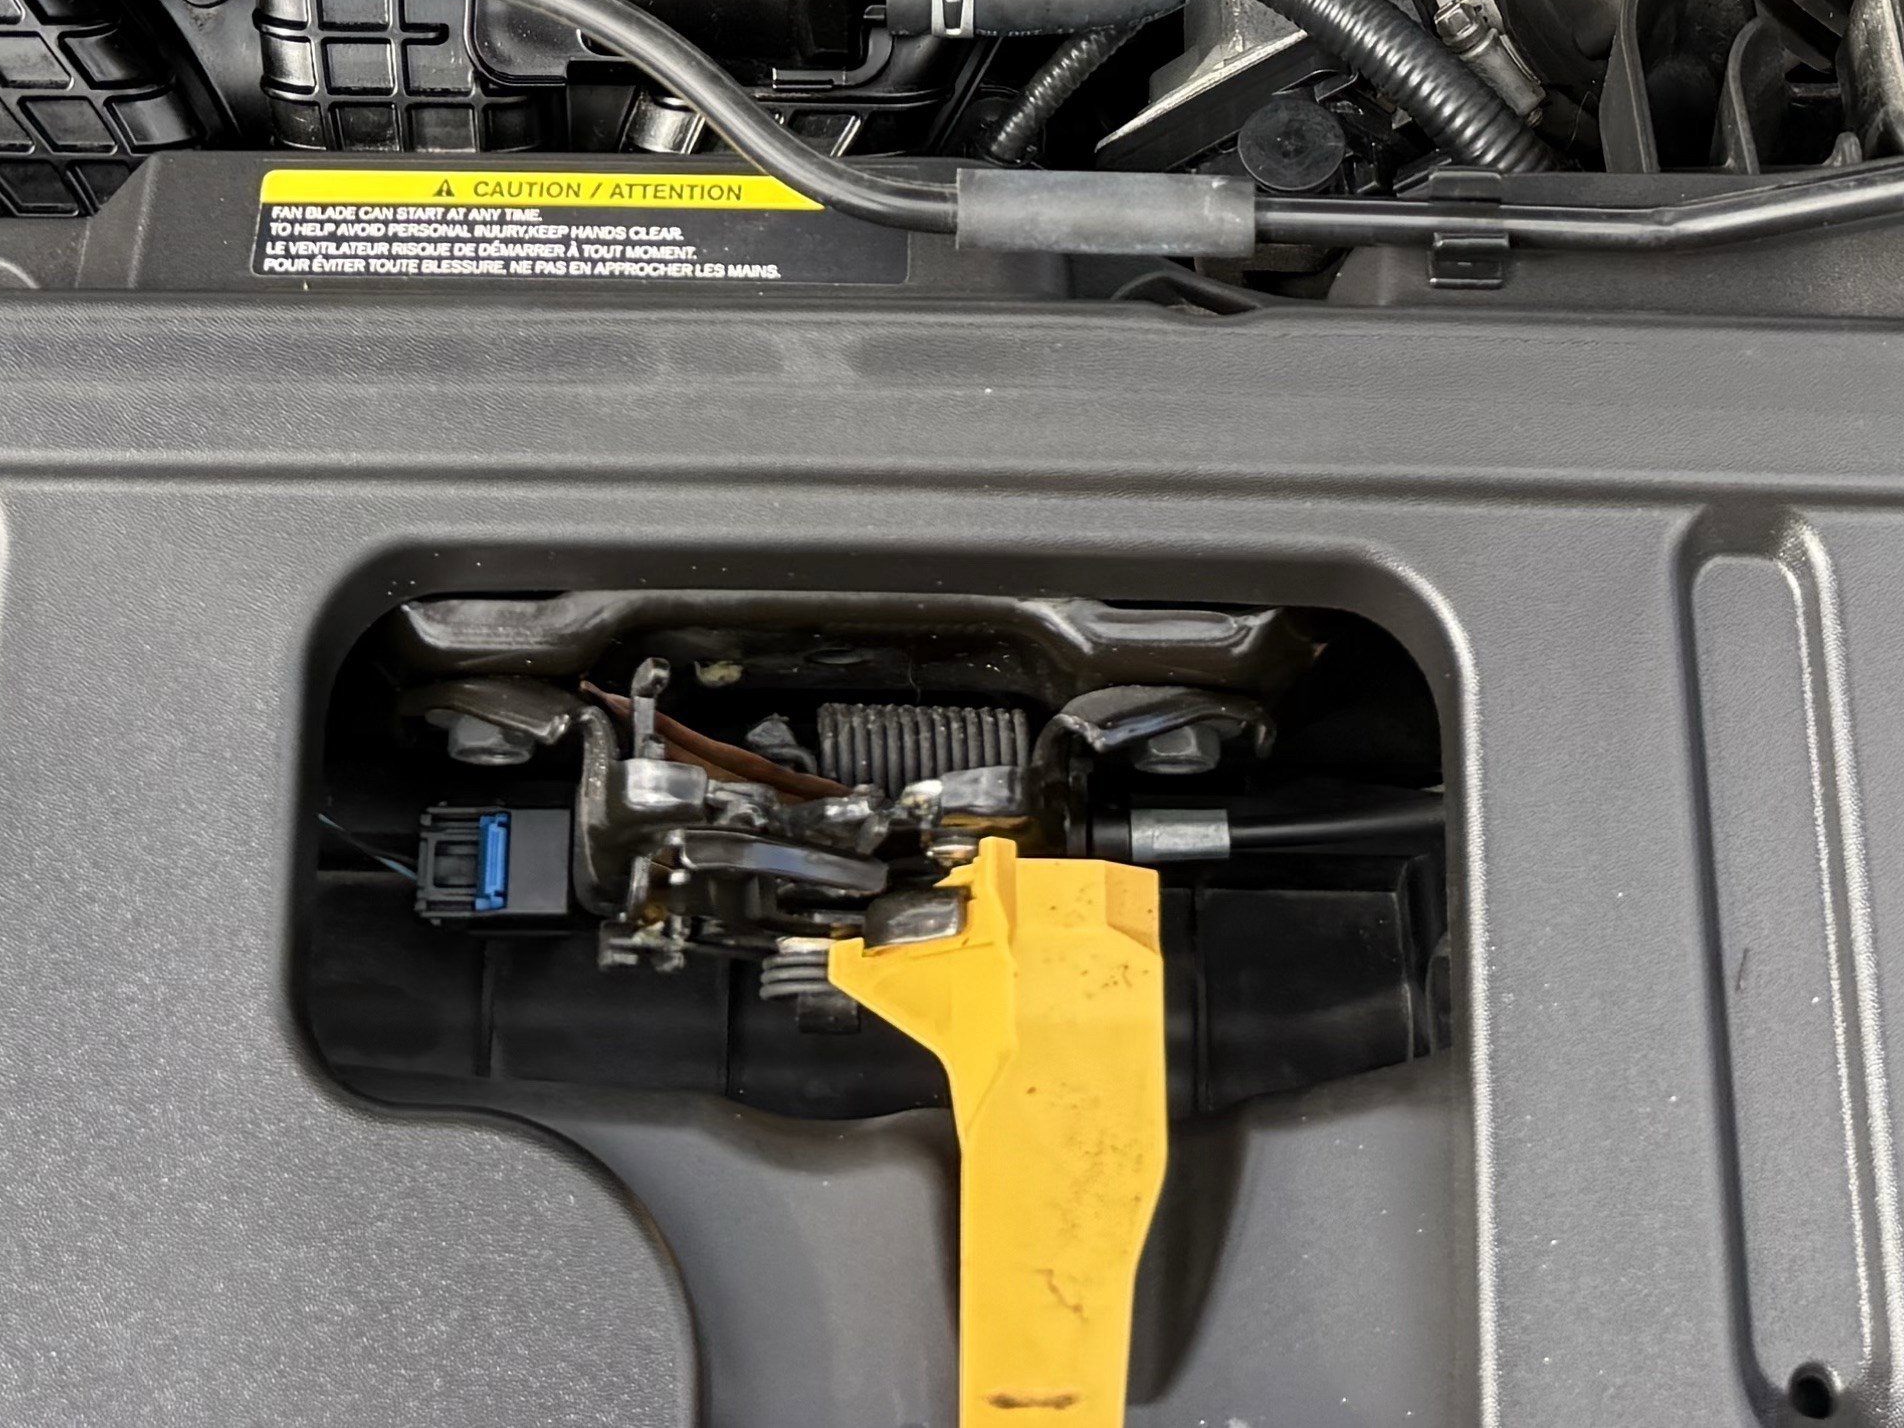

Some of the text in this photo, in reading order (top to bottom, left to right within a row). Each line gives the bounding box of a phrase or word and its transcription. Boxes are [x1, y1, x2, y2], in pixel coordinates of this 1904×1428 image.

[473, 180, 743, 202] CAUTION / ATTENTION
[271, 205, 543, 222] FAN BLADE CAN START AT ANY TIME.
[269, 222, 293, 237] TO
[294, 222, 337, 237] HELP
[337, 223, 386, 238] AVOID
[388, 223, 472, 238] PERSONAL
[570, 225, 627, 240] HANDS
[265, 240, 697, 260] LE VENTILATEUR RISQUE DE DÉMARRER À TOUT MOMENT.
[263, 257, 311, 272] POUR
[311, 254, 366, 273] ÉVITER
[368, 258, 419, 274] TOUTE
[509, 260, 533, 275] NE
[534, 260, 566, 275] PAS
[568, 261, 592, 275] EN
[593, 261, 694, 277] APPROCHER
[695, 263, 725, 278] LES
[727, 264, 781, 279] MAINS.
